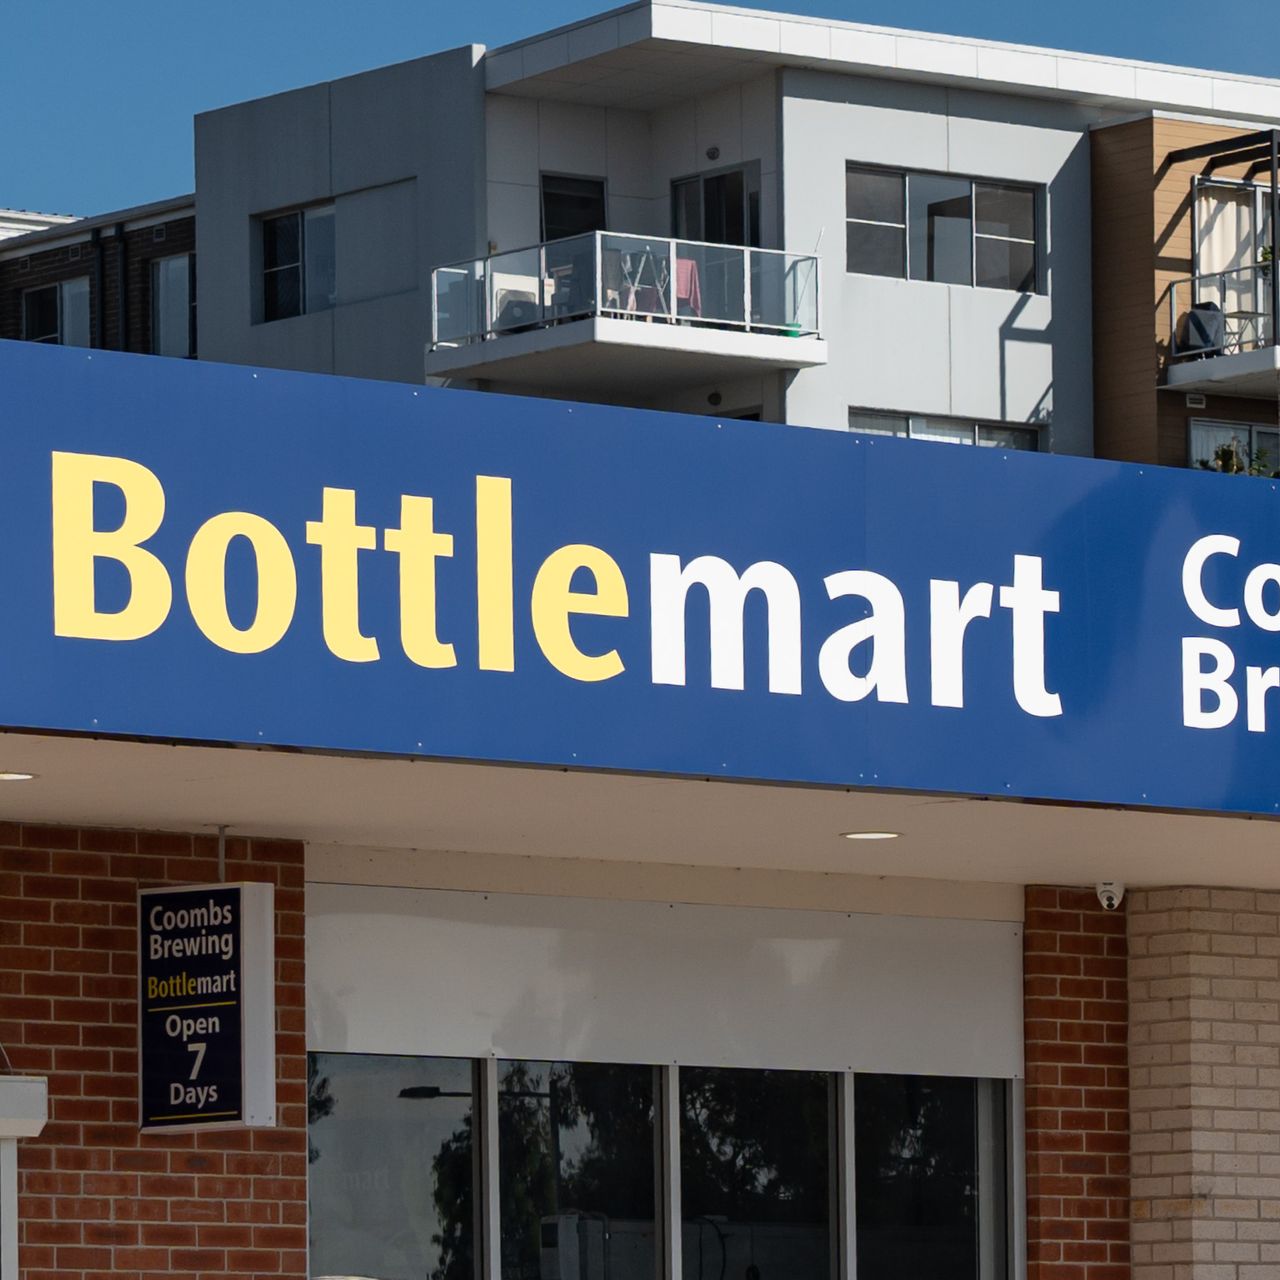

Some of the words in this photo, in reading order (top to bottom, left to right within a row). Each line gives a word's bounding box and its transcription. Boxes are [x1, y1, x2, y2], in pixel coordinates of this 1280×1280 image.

[52, 450, 1063, 718] Bottlemart
[150, 899, 233, 931] Coombs
[149, 929, 233, 960] Brewing
[148, 970, 236, 999] Bottlemart
[166, 1014, 220, 1041] Open
[187, 1042, 207, 1080] 7
[170, 1082, 218, 1109] Days
